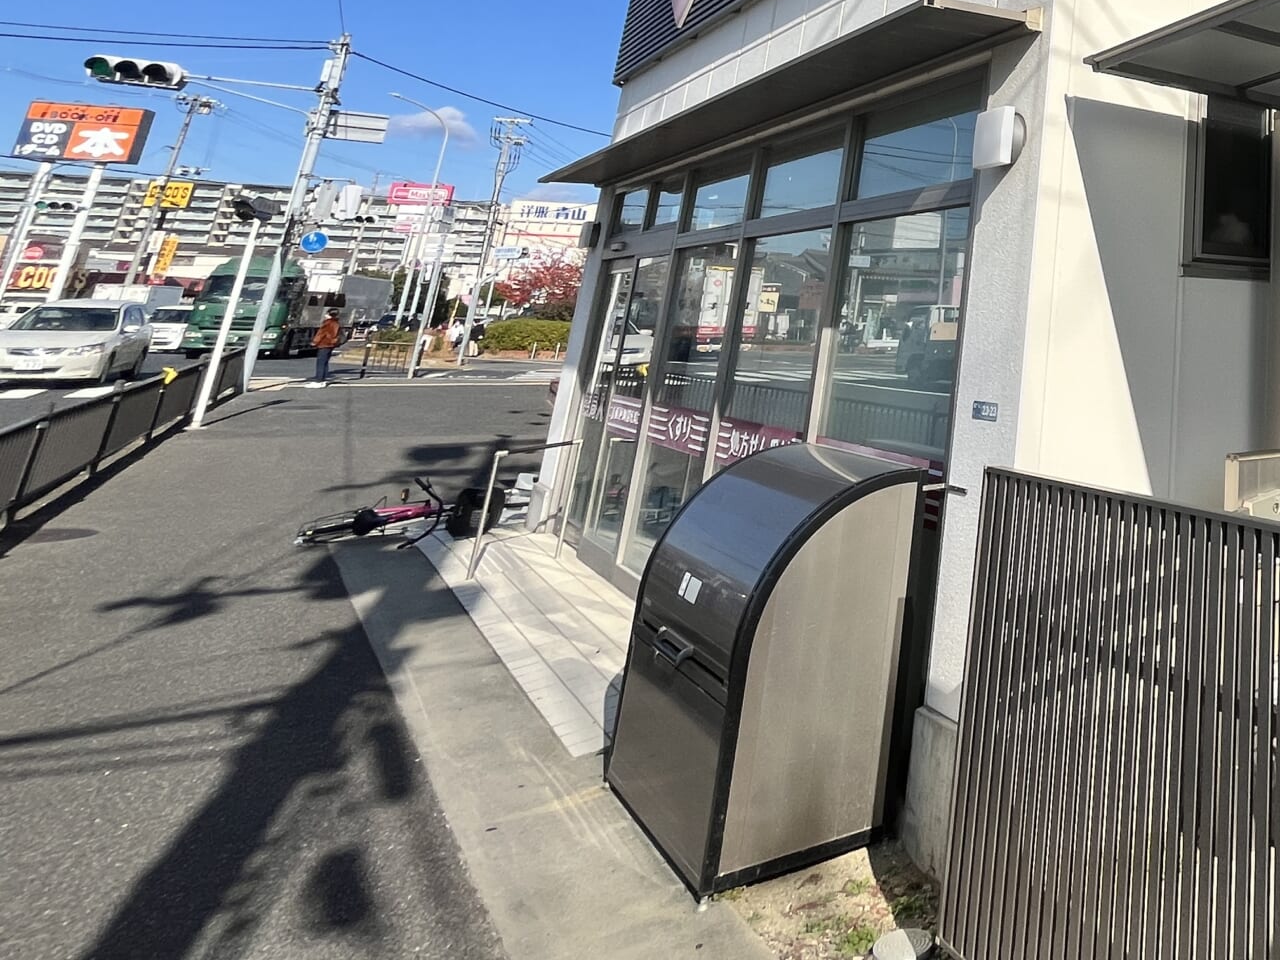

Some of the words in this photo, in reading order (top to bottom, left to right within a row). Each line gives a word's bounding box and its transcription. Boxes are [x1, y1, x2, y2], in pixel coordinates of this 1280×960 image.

[30, 122, 67, 134] DVD
[31, 133, 59, 145] CD
[71, 127, 129, 157] 本
[146, 186, 189, 199] CCO'S
[668, 414, 692, 442] くすり
